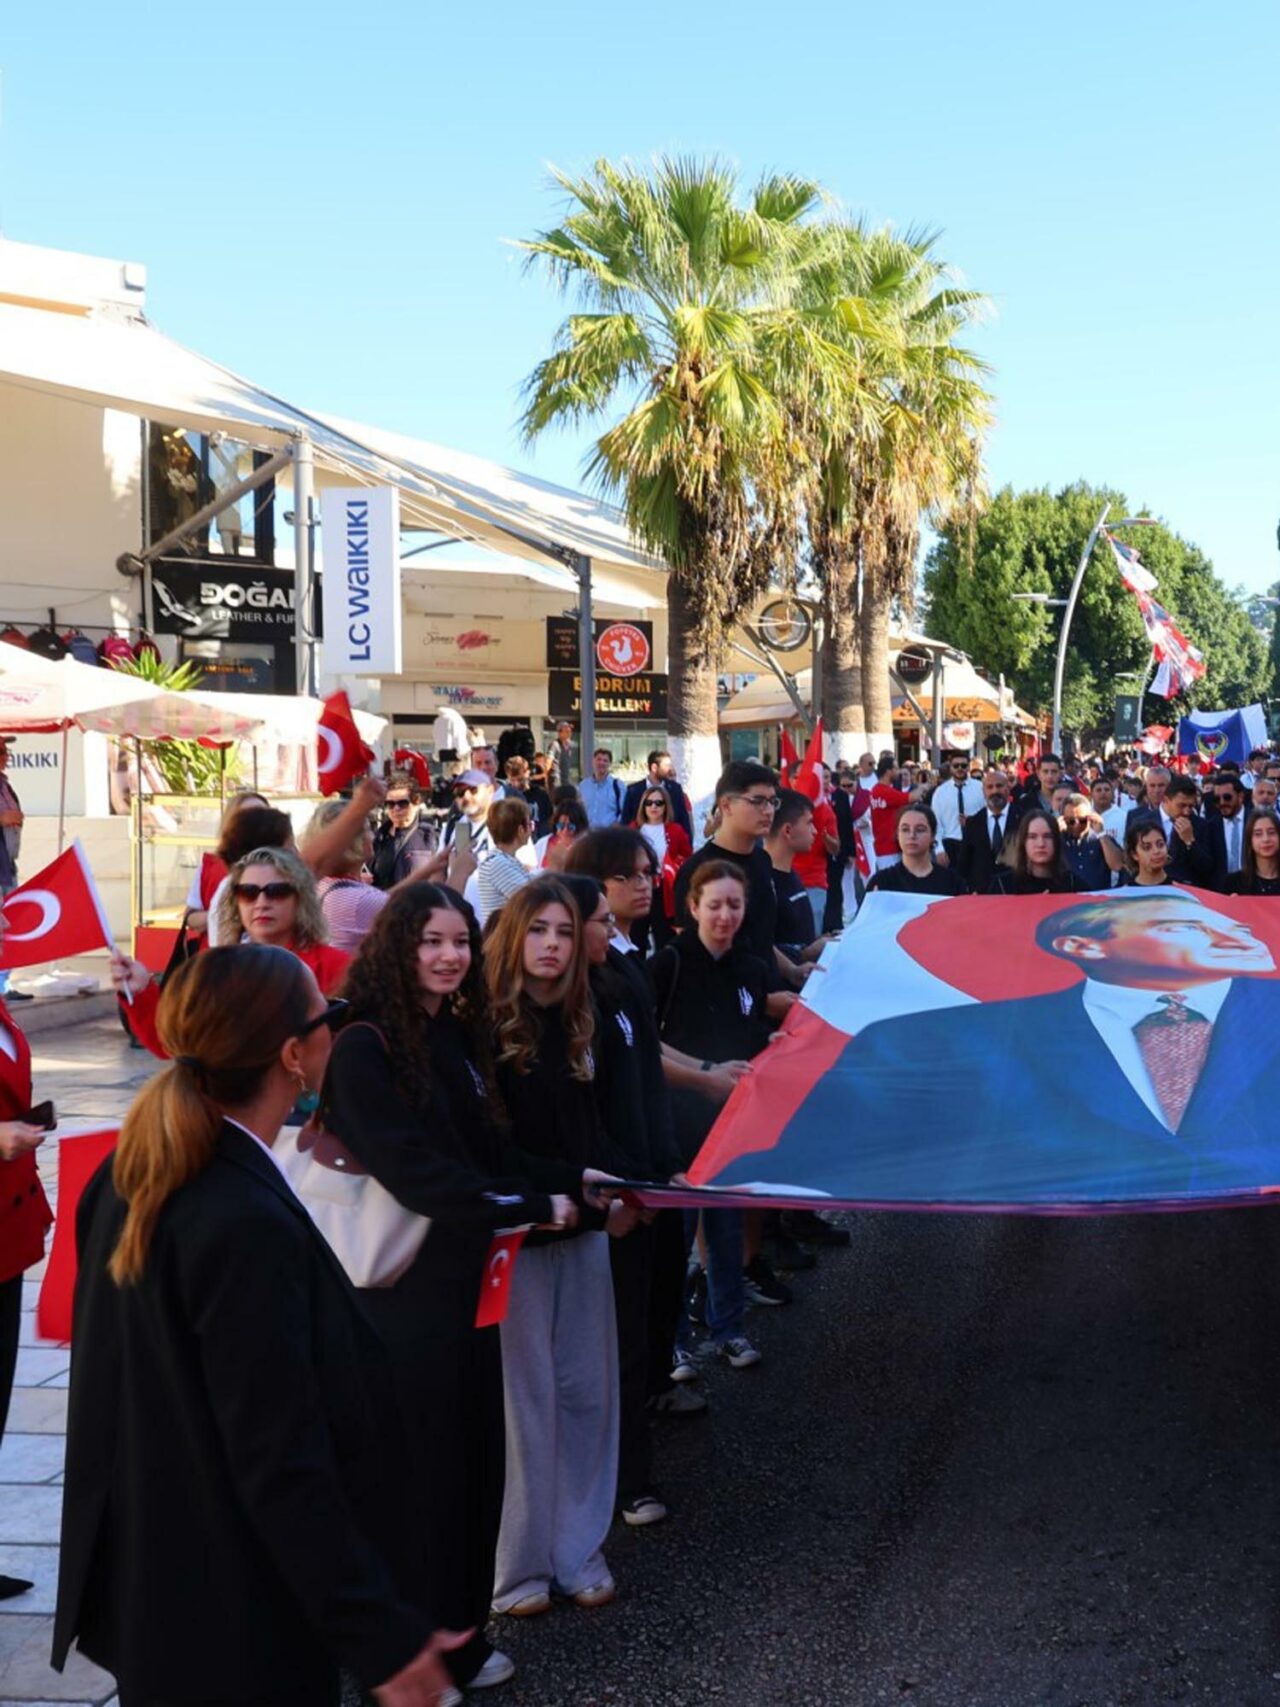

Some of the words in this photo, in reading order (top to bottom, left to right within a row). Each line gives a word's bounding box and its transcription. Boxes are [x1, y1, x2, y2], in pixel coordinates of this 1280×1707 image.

[211, 610, 262, 623] LEATHER
[265, 613, 273, 623] &
[348, 623, 371, 661] LC
[573, 677, 651, 694] BDRUM
[570, 698, 651, 713] JELLERY
